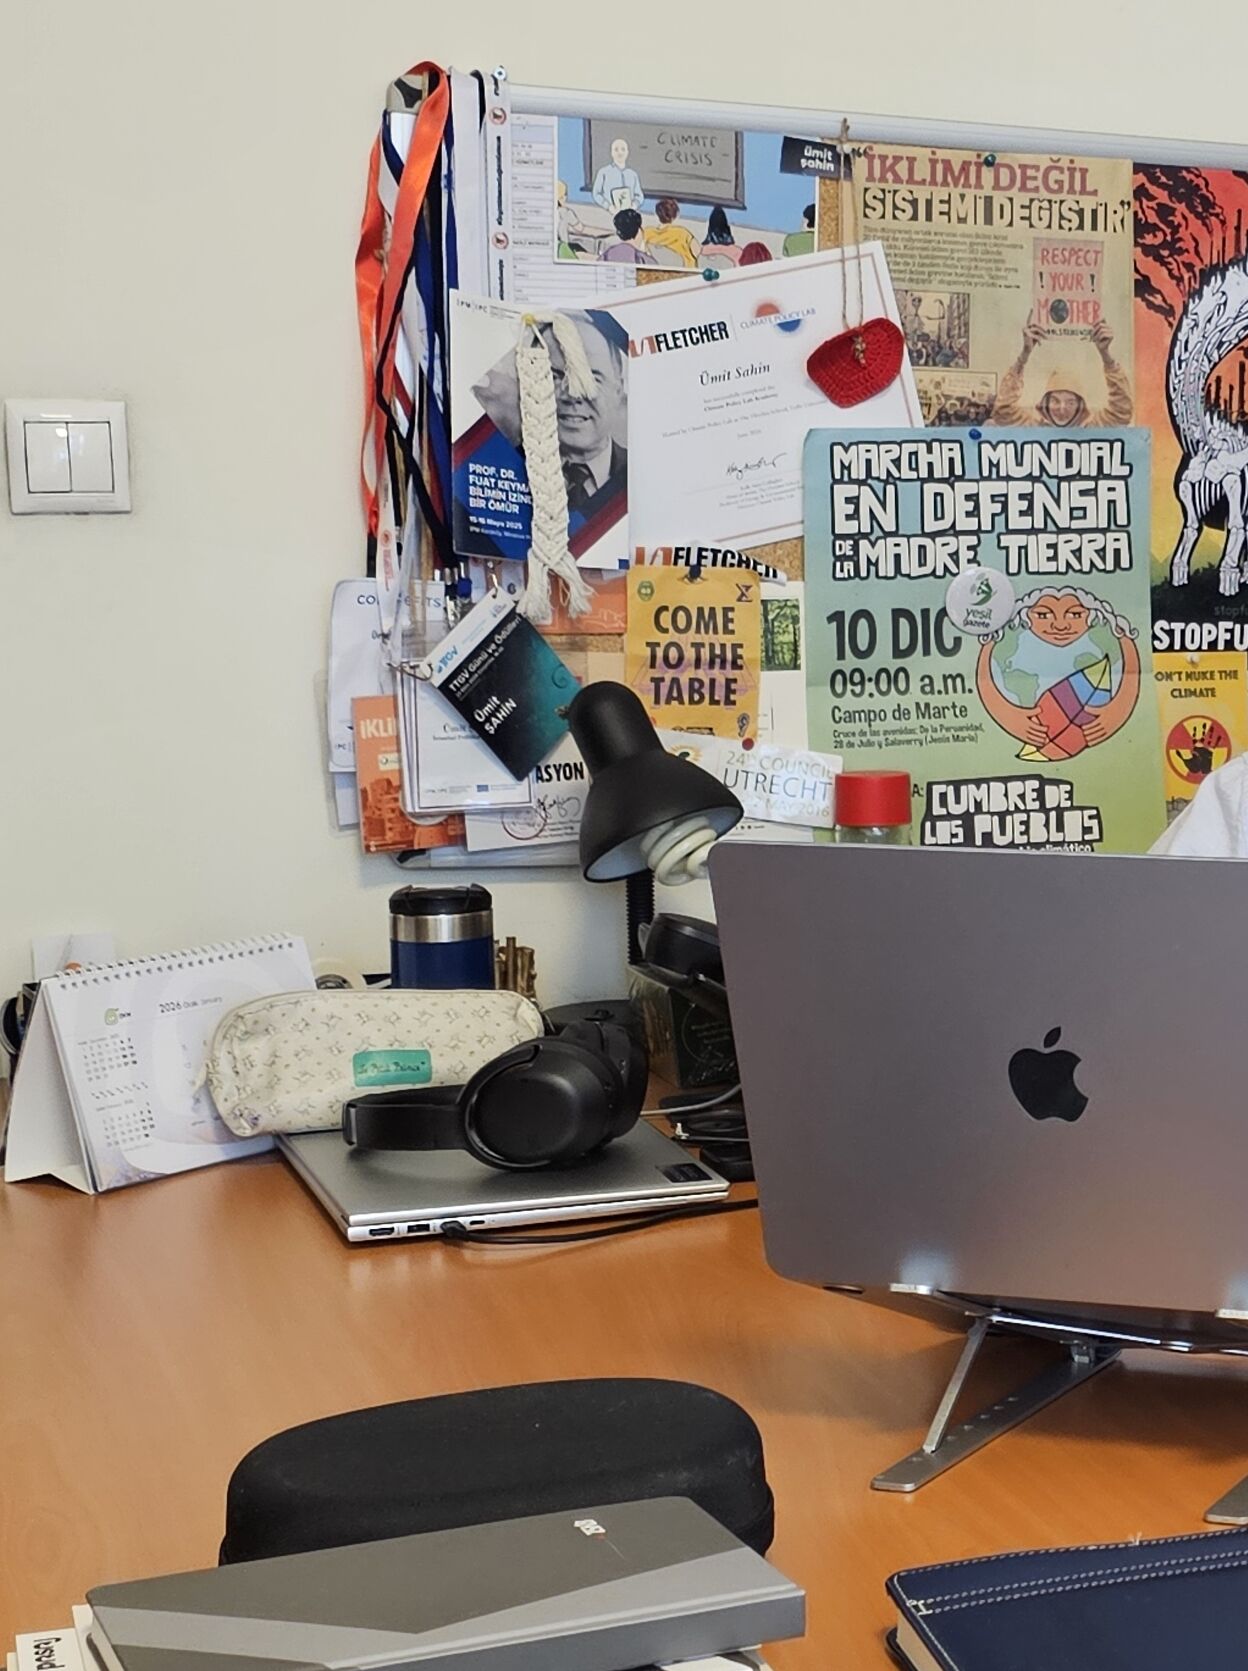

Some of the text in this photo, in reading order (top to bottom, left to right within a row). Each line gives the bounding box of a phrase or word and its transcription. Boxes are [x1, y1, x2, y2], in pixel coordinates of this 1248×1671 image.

[657, 131, 718, 149] CLIMATE
[804, 144, 834, 161] ümit
[664, 149, 714, 167] CRISIS
[800, 158, 835, 173] şahin
[992, 157, 1098, 197] DEĞİL
[864, 187, 985, 226] SİSTEMİ
[1041, 247, 1102, 267] RESPECT
[1050, 272, 1084, 292] YOUR
[655, 321, 730, 352] FLETCHER
[699, 362, 771, 386] Ümit Sahin
[469, 463, 517, 481] PROF. DR.
[833, 441, 1130, 480] MARCHA MUNDIAL
[469, 474, 496, 488] FUAT
[469, 496, 520, 515] BİR ÖMÜR
[833, 483, 896, 534] EN
[923, 480, 1128, 533] DEFENSA
[835, 540, 853, 556] DE
[860, 533, 1130, 578] MADRE TIERRA
[835, 561, 854, 578] LA
[654, 605, 736, 635] COME
[826, 607, 963, 661] 10 DIC
[448, 670, 471, 693] TTGV
[468, 650, 489, 676] Günü
[494, 615, 523, 646] Ödülleri
[646, 642, 744, 671] TO THE
[830, 667, 973, 700] 09:00 a.m.
[1154, 670, 1239, 682] ON'T NUKE THE
[650, 677, 738, 706] TABLE
[1170, 687, 1217, 699] CLIMATE
[472, 694, 501, 723] Ümit
[484, 697, 518, 736] ŞAHİN
[831, 701, 969, 727] Campo de Marte
[833, 729, 856, 739] Cruce
[857, 728, 868, 738] de
[869, 727, 882, 737] las
[833, 739, 845, 749] 28
[846, 738, 856, 748] de
[857, 737, 876, 748] Julio
[884, 736, 923, 749] Salaverry
[759, 756, 833, 780] COUNCIL
[723, 767, 832, 803] UTRECHT
[931, 780, 1071, 816] CUMBRE DE
[925, 809, 1100, 847] LOS PUEBLOS
